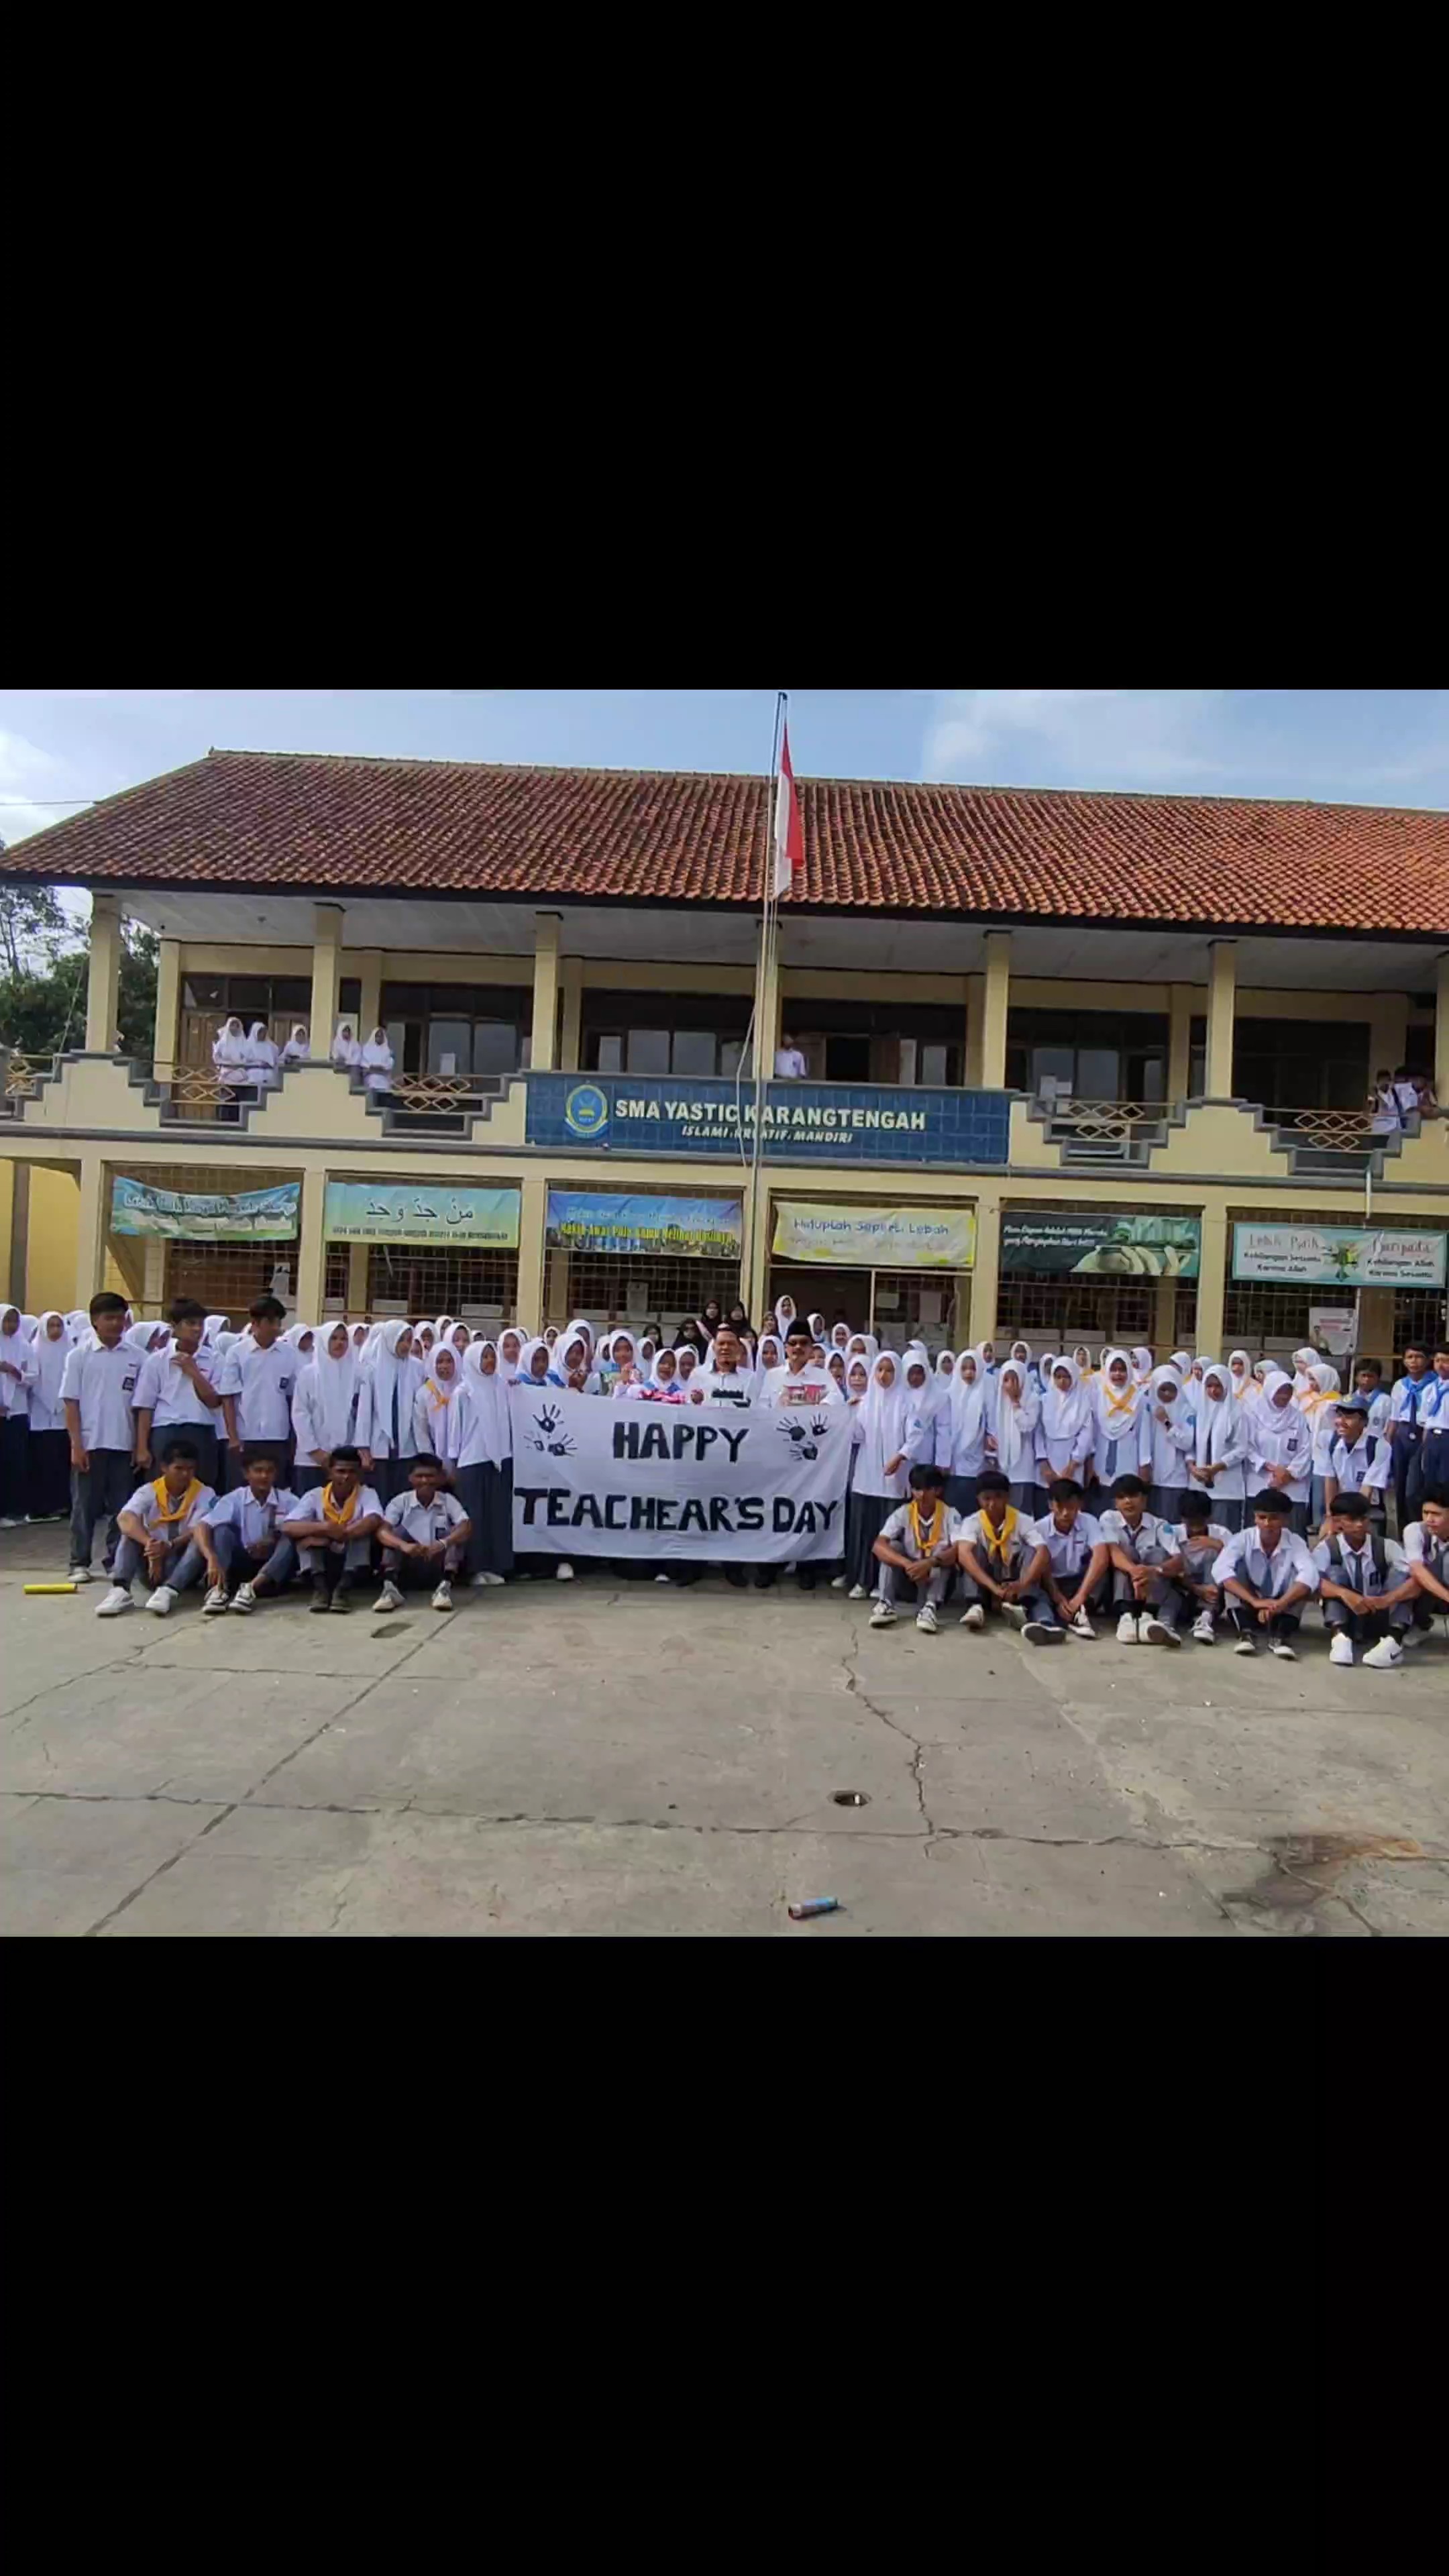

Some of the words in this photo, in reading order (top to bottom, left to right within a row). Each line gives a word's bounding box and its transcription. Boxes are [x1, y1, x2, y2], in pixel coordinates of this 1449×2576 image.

[616, 1099, 660, 1118] SMA
[665, 1102, 739, 1123] YASTIC
[745, 1106, 926, 1131] KARANGTENGAH
[792, 1130, 853, 1144] MANDIRI
[612, 1421, 749, 1462] HAPPY
[773, 1497, 838, 1534] DAY
